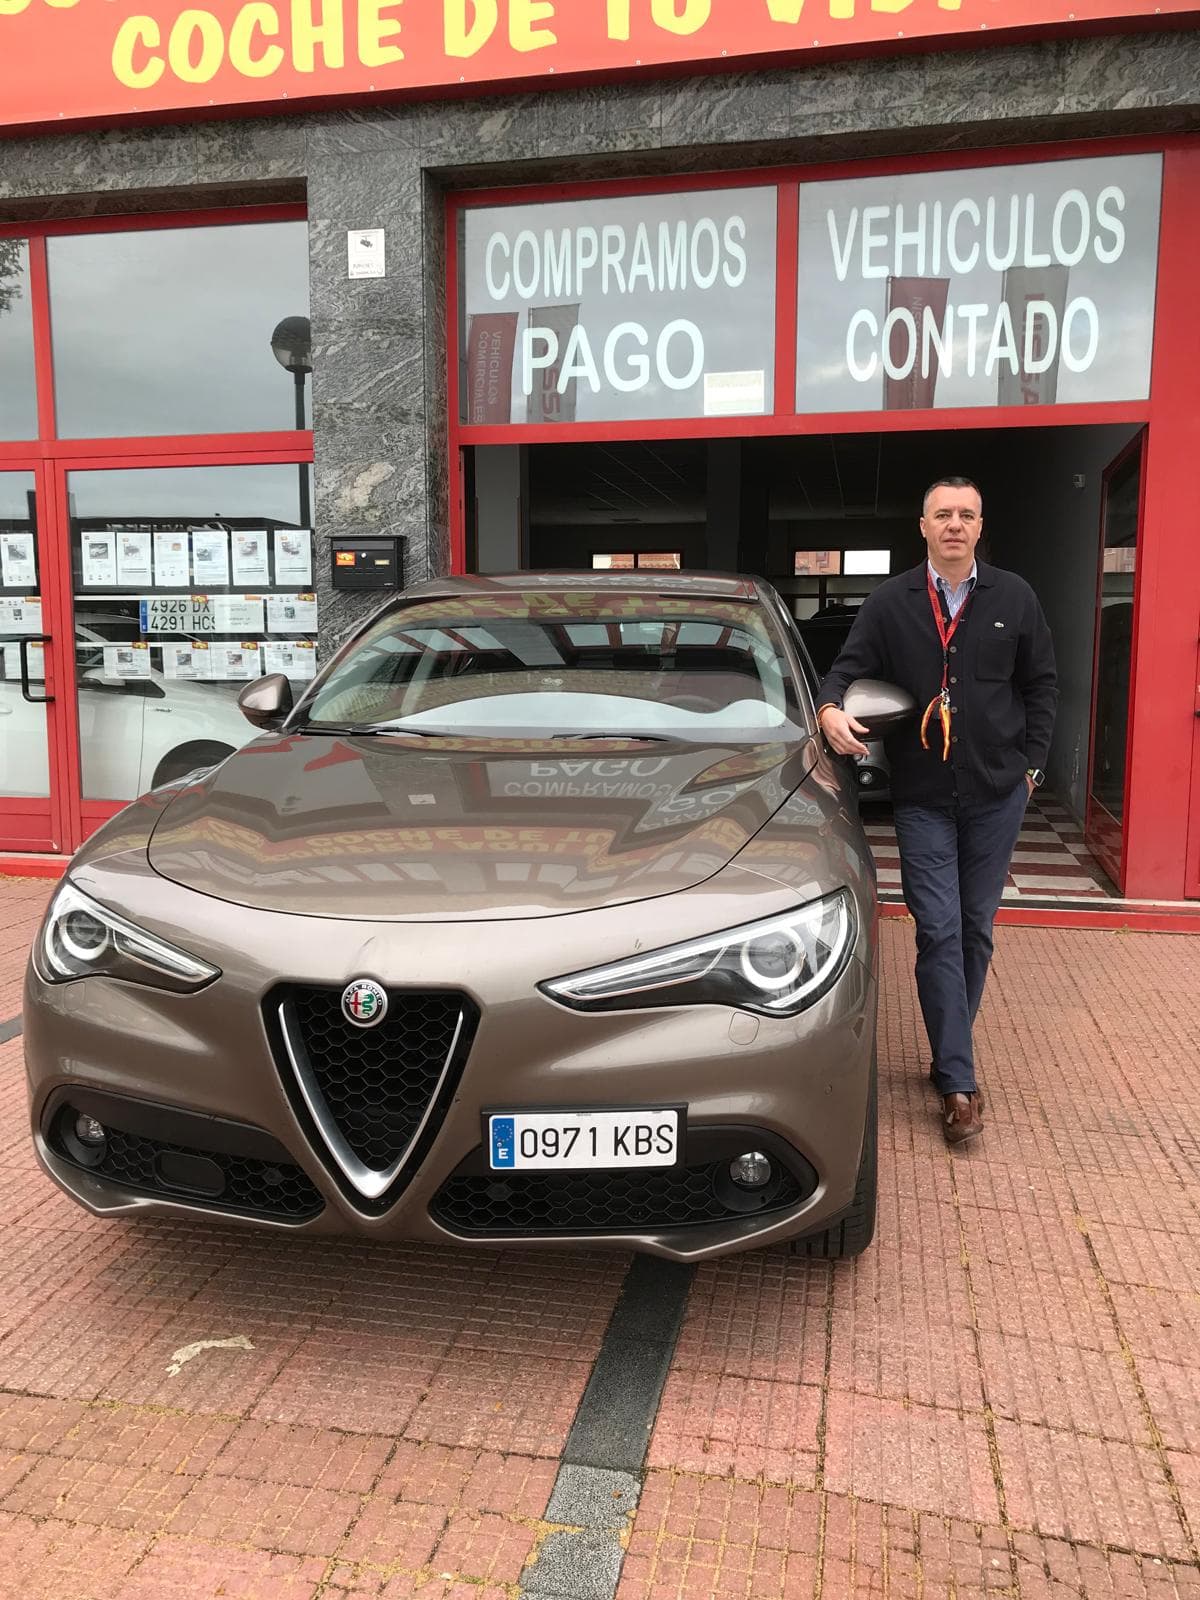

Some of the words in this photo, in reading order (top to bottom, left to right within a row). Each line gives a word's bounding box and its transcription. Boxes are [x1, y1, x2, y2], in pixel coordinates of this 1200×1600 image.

[112, 0, 405, 89] COCHE
[443, 0, 558, 58] DE
[485, 215, 747, 301] COMPRAMOS
[826, 186, 1126, 282] VEHICULOS
[522, 318, 705, 395] PAGO
[846, 296, 1100, 382] CONTADO
[151, 600, 187, 613] 4926
[151, 616, 185, 631] 4291
[498, 1148, 509, 1160] E
[520, 1127, 598, 1158] 0971
[613, 1124, 674, 1156] KBS
